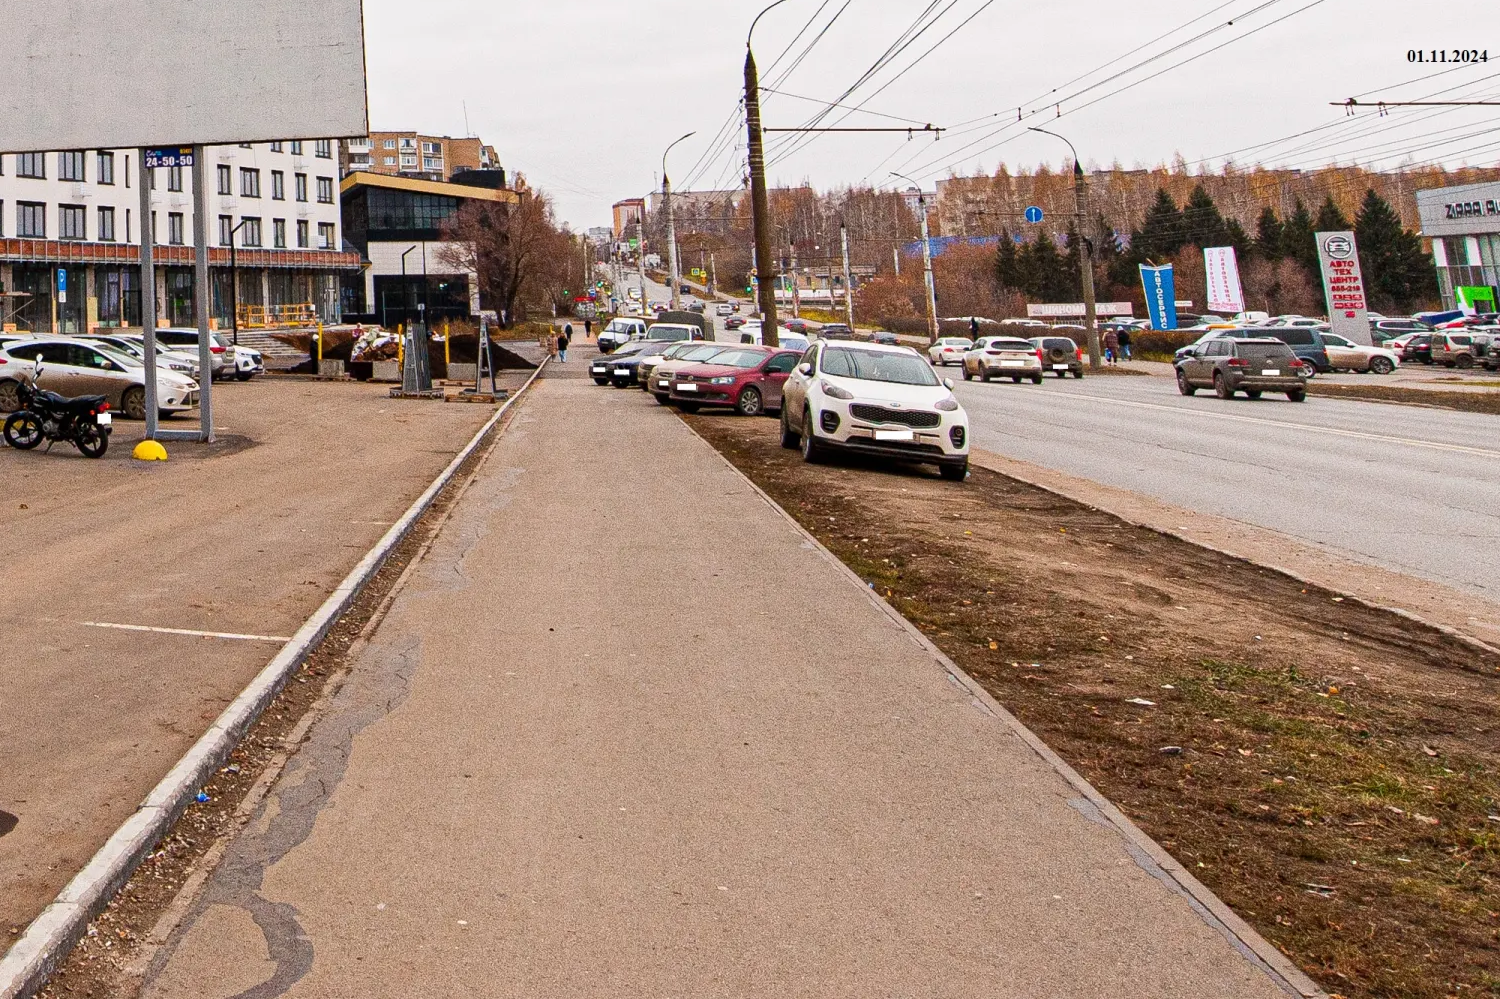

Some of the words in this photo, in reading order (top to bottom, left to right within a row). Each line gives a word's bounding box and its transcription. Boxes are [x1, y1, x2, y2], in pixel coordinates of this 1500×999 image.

[146, 155, 193, 167] 24-50-50
[1154, 270, 1168, 329] АВТОСЕРВИС
[1041, 304, 1117, 315] ШИНОМОТАЖ
